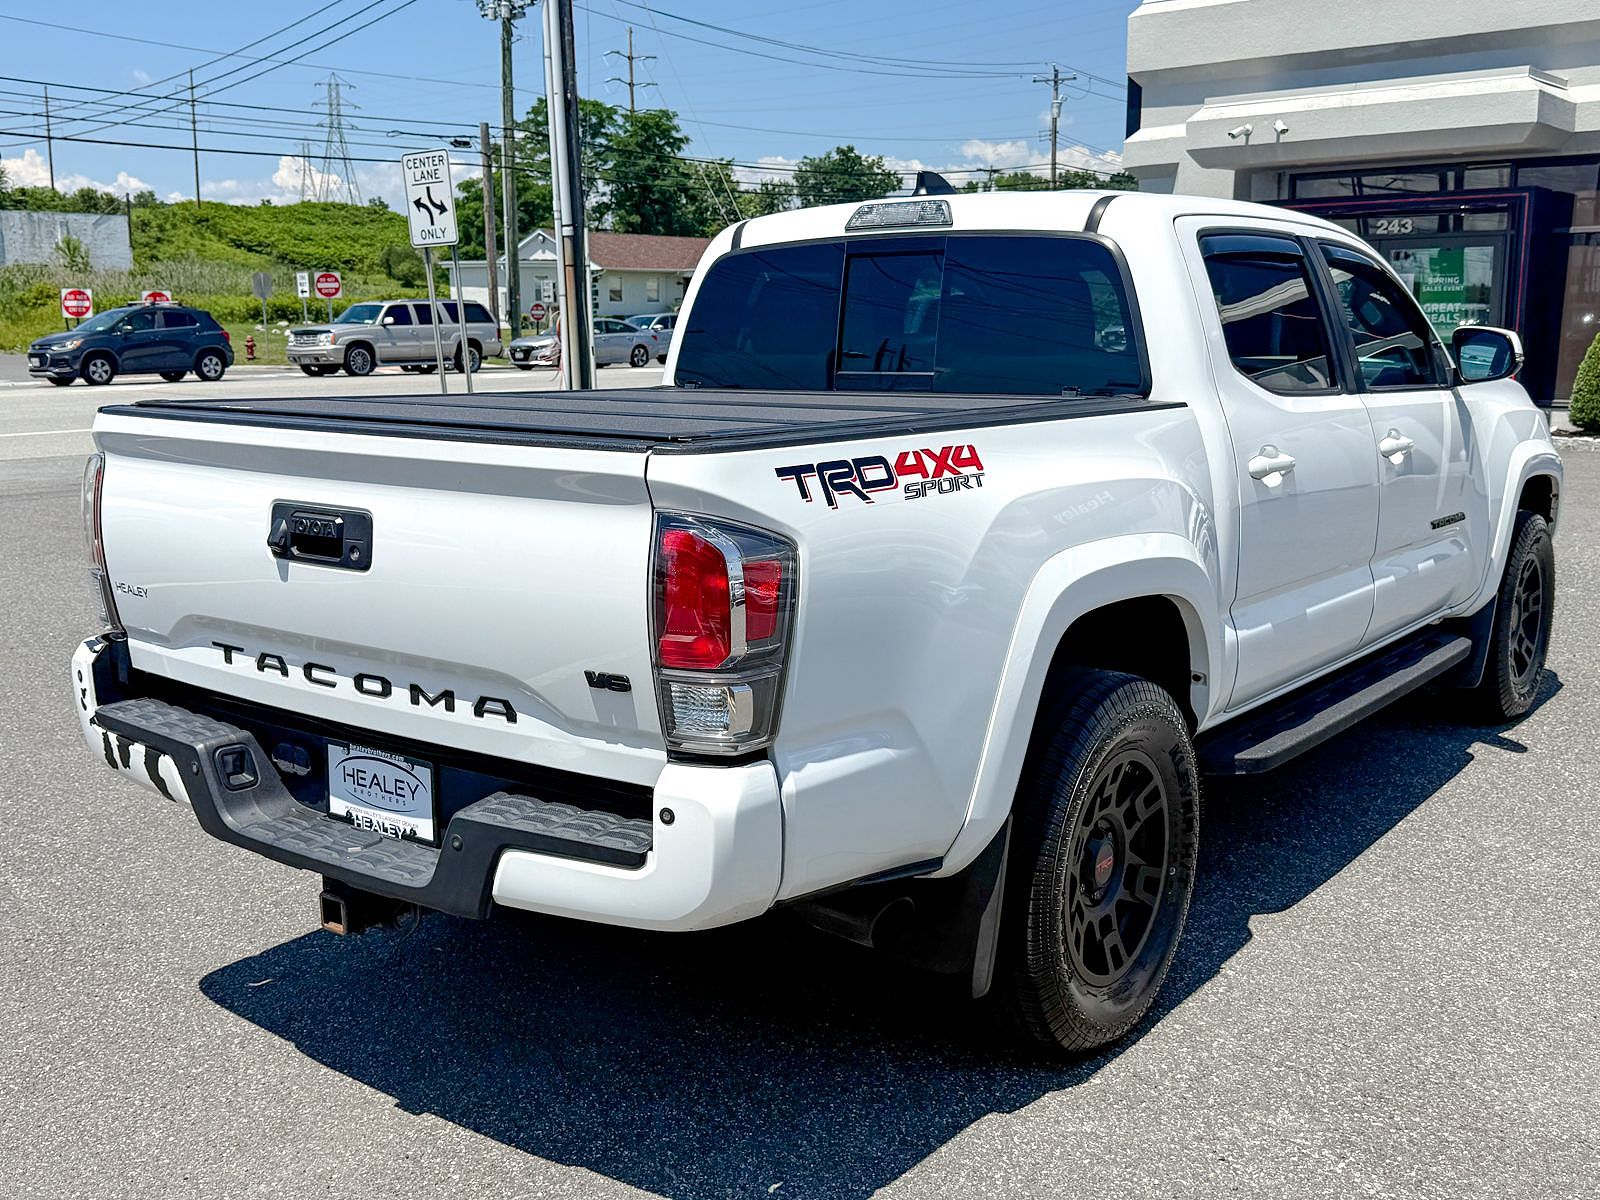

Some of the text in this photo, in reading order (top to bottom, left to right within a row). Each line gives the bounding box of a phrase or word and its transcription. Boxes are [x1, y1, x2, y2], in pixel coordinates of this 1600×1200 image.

[406, 155, 445, 170] CENTER
[413, 168, 440, 182] LANE
[420, 227, 447, 240] ONLY
[1376, 219, 1413, 234] 243
[1427, 276, 1460, 285] SPRING
[1423, 303, 1462, 313] GREAT
[775, 454, 900, 511] TRD
[903, 472, 986, 501] SPORT
[291, 517, 337, 537] TOYOTA
[115, 581, 148, 599] HEALEY
[212, 641, 518, 724] TACOMA
[584, 670, 633, 693] V6
[343, 766, 419, 800] HEALEY
[353, 788, 407, 806] BROTHERS
[354, 814, 403, 839] HEALEY
